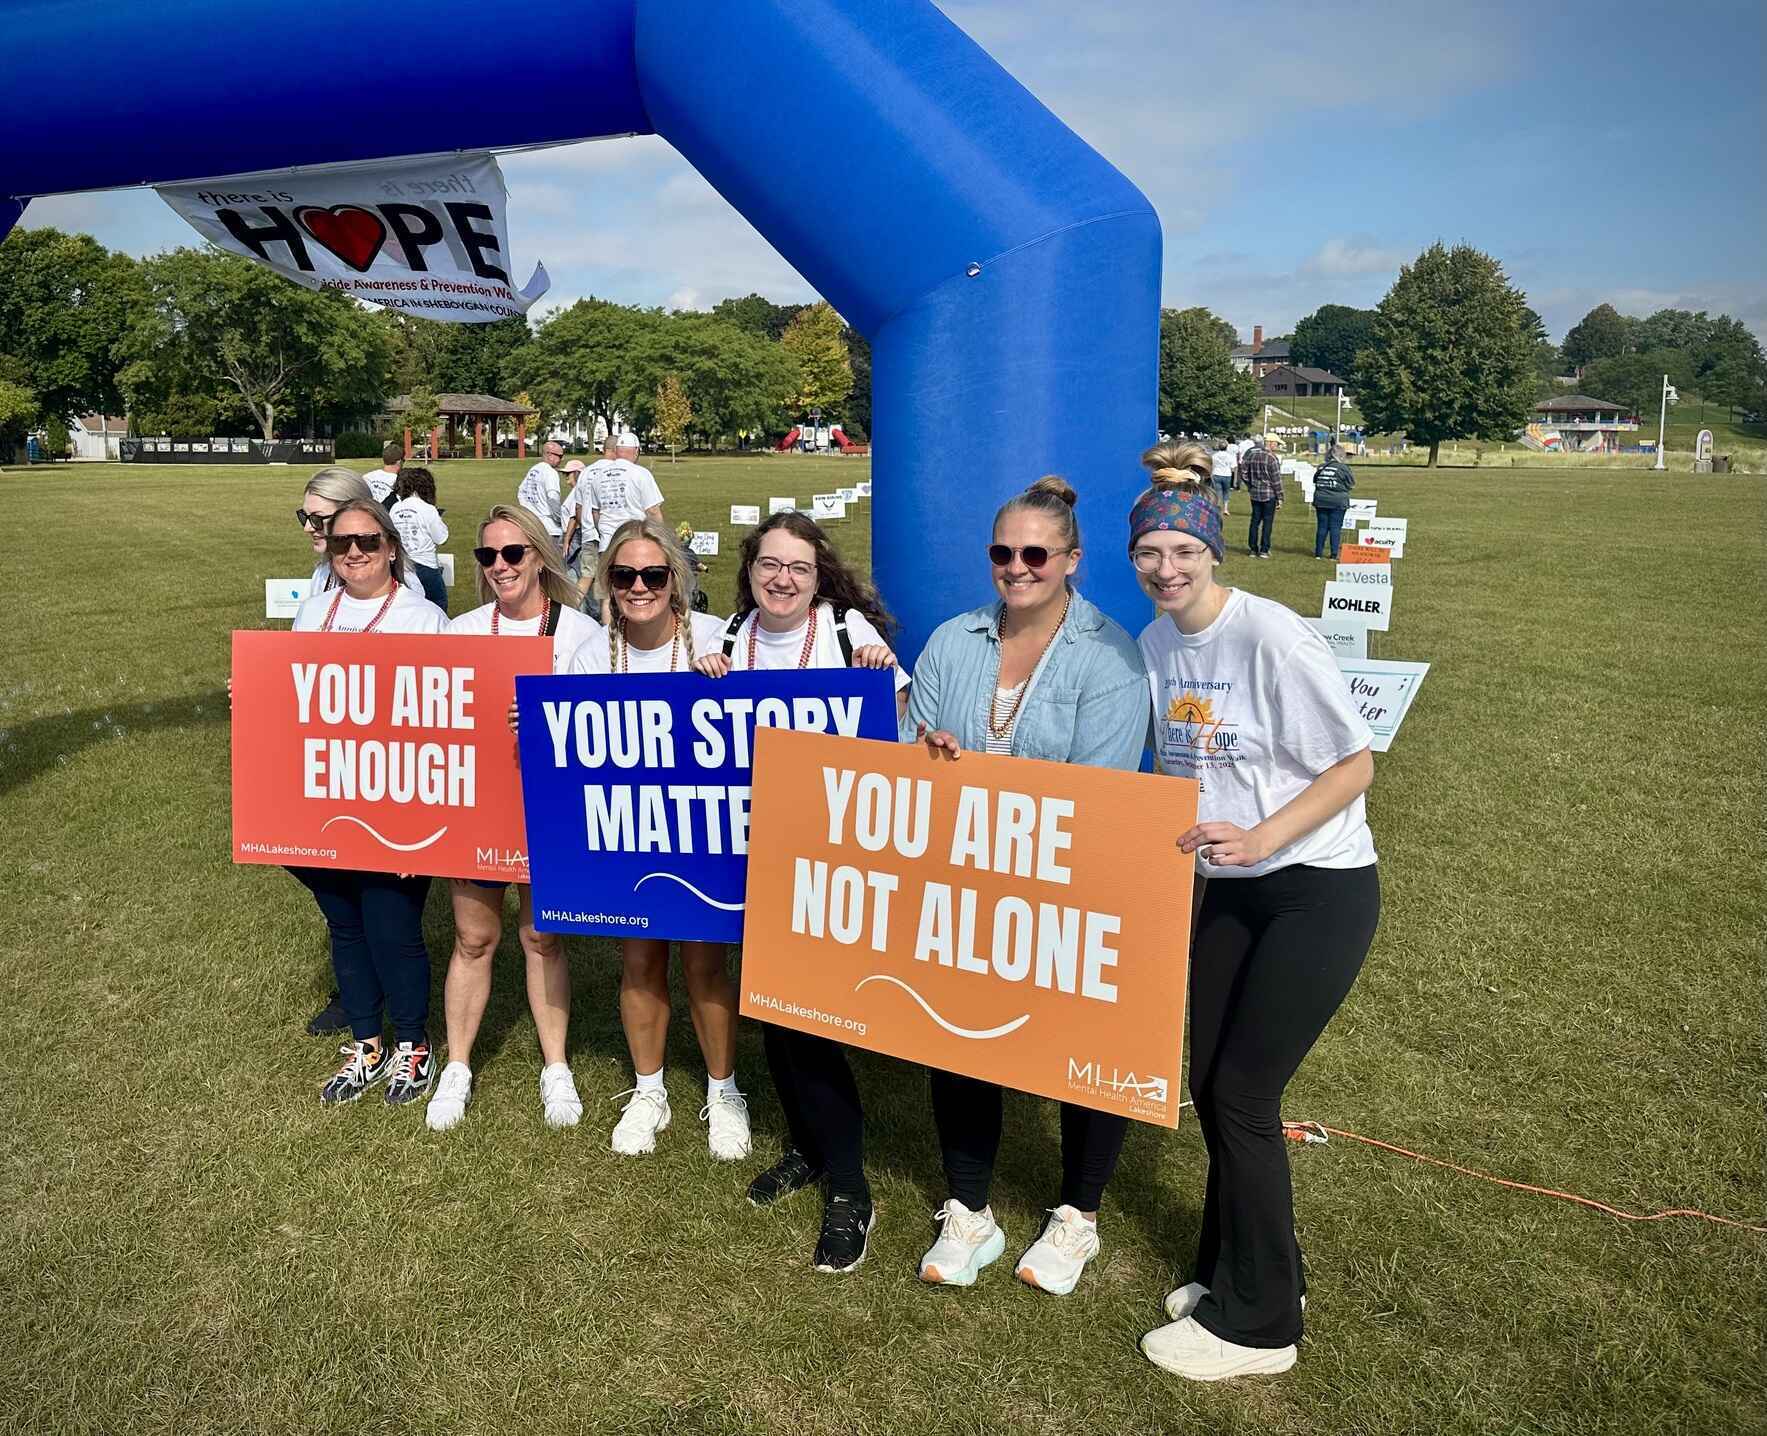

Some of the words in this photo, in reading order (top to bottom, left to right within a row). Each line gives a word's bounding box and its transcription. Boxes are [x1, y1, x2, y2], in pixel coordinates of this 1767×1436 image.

[198, 190, 264, 206] there
[267, 190, 294, 202] is
[354, 279, 417, 290] Awareness
[421, 279, 430, 290] &
[431, 279, 492, 297] Prevention
[493, 286, 513, 300] Wa
[411, 300, 422, 308] IN
[423, 300, 491, 312] SHEBOYGAN
[1352, 572, 1388, 584] Vesta
[1328, 597, 1381, 613] KOHLER
[1333, 633, 1354, 641] Creek
[1179, 677, 1232, 694] Anniversary
[1350, 677, 1380, 696] You
[290, 663, 376, 726] YOU
[390, 665, 475, 730] ARE
[1359, 702, 1387, 720] ter
[542, 700, 675, 769] YOUR
[1191, 718, 1238, 754] Hope
[303, 737, 476, 808] ENOUGH
[583, 784, 751, 855] MATTE
[822, 766, 933, 859] YOU
[949, 785, 1074, 885] ARE
[241, 843, 337, 860] MHALakeshore.org
[477, 847, 526, 866] MHA
[542, 910, 649, 928] MHALakeshore.org
[791, 857, 898, 953] NOT
[914, 881, 1121, 1003] ALONE
[749, 991, 867, 1035] MHALakeshore.org
[1068, 1057, 1142, 1097] MHA
[1067, 1081, 1097, 1096] Mental
[1099, 1088, 1128, 1103] Health
[1130, 1096, 1167, 1112] America
[1129, 1105, 1166, 1120] Lakeshore
